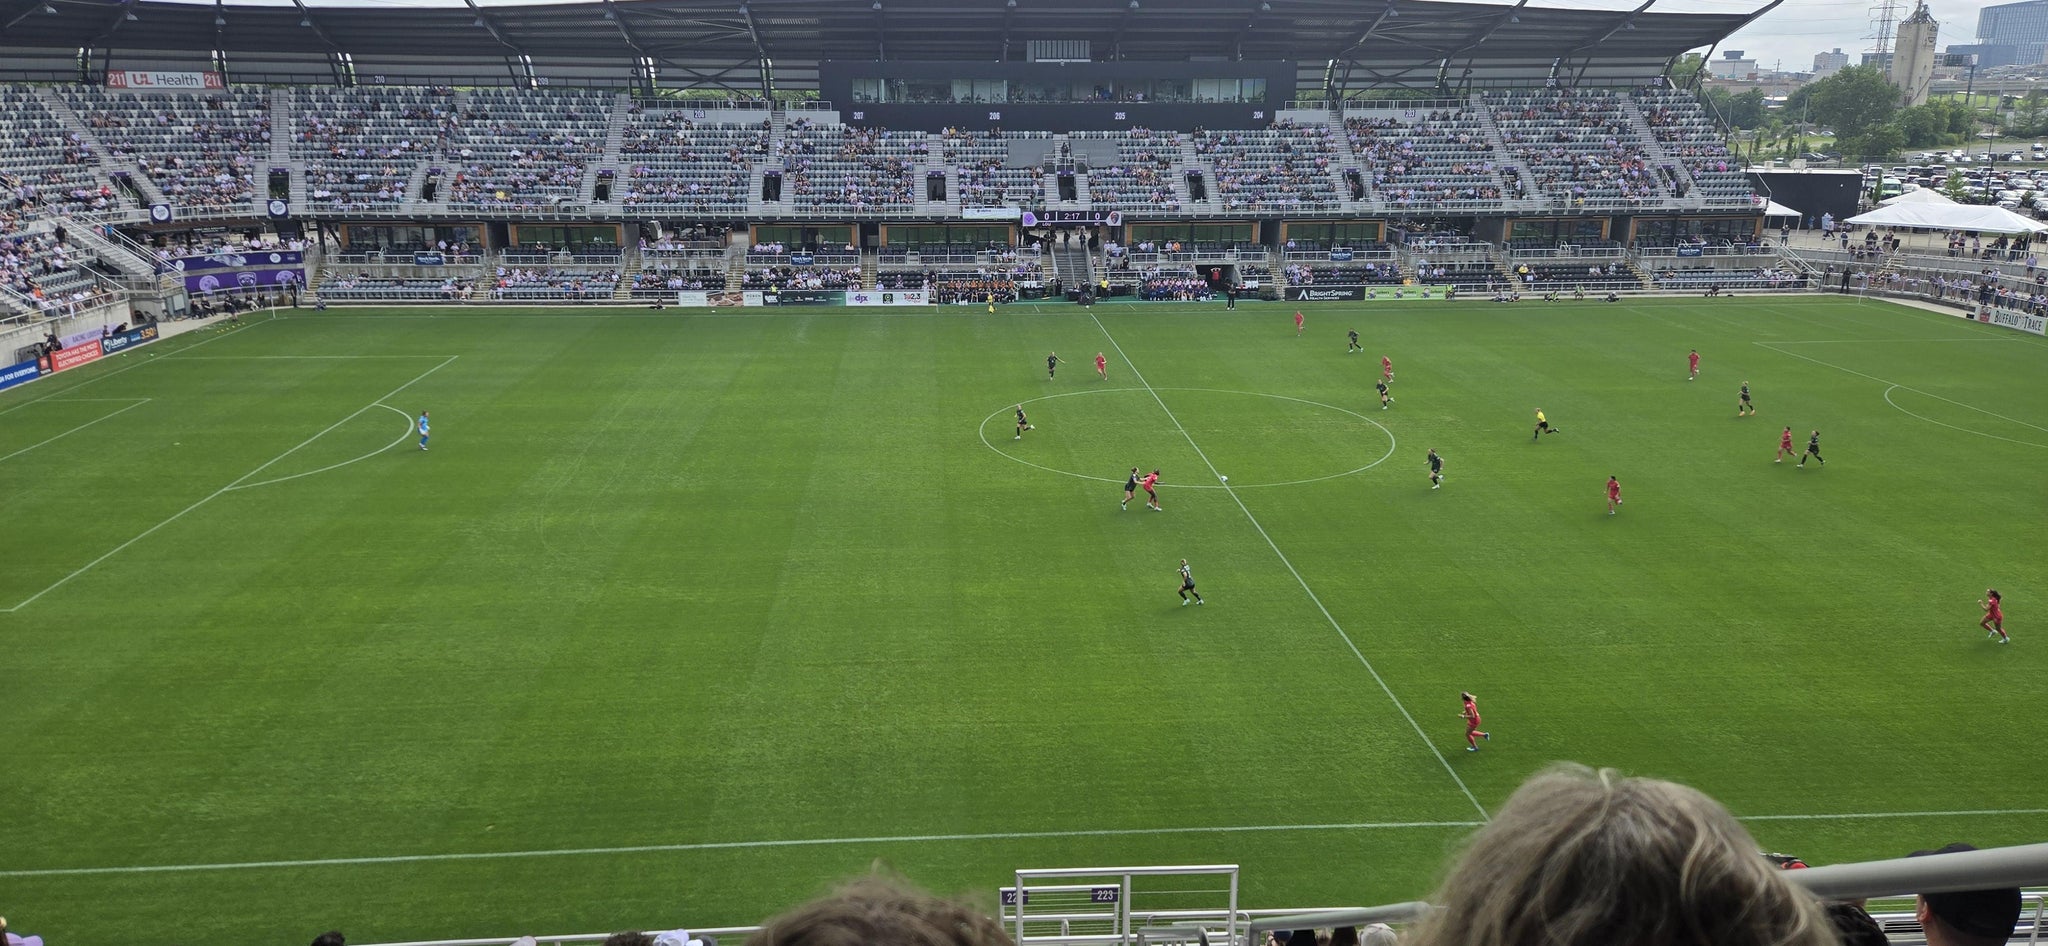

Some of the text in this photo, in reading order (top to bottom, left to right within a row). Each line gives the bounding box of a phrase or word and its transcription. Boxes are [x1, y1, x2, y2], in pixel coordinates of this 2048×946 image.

[108, 73, 126, 85] 211
[156, 74, 199, 86] Health
[204, 74, 222, 86] 211
[853, 111, 863, 120] 207
[1115, 112, 1126, 120] 205
[1253, 111, 1263, 119] 204
[1994, 310, 2019, 326] BUFFALO
[2024, 316, 2042, 331] TRACE
[111, 336, 127, 346] Liberty
[4, 373, 14, 381] FOR
[1007, 890, 1113, 903] 22 223
